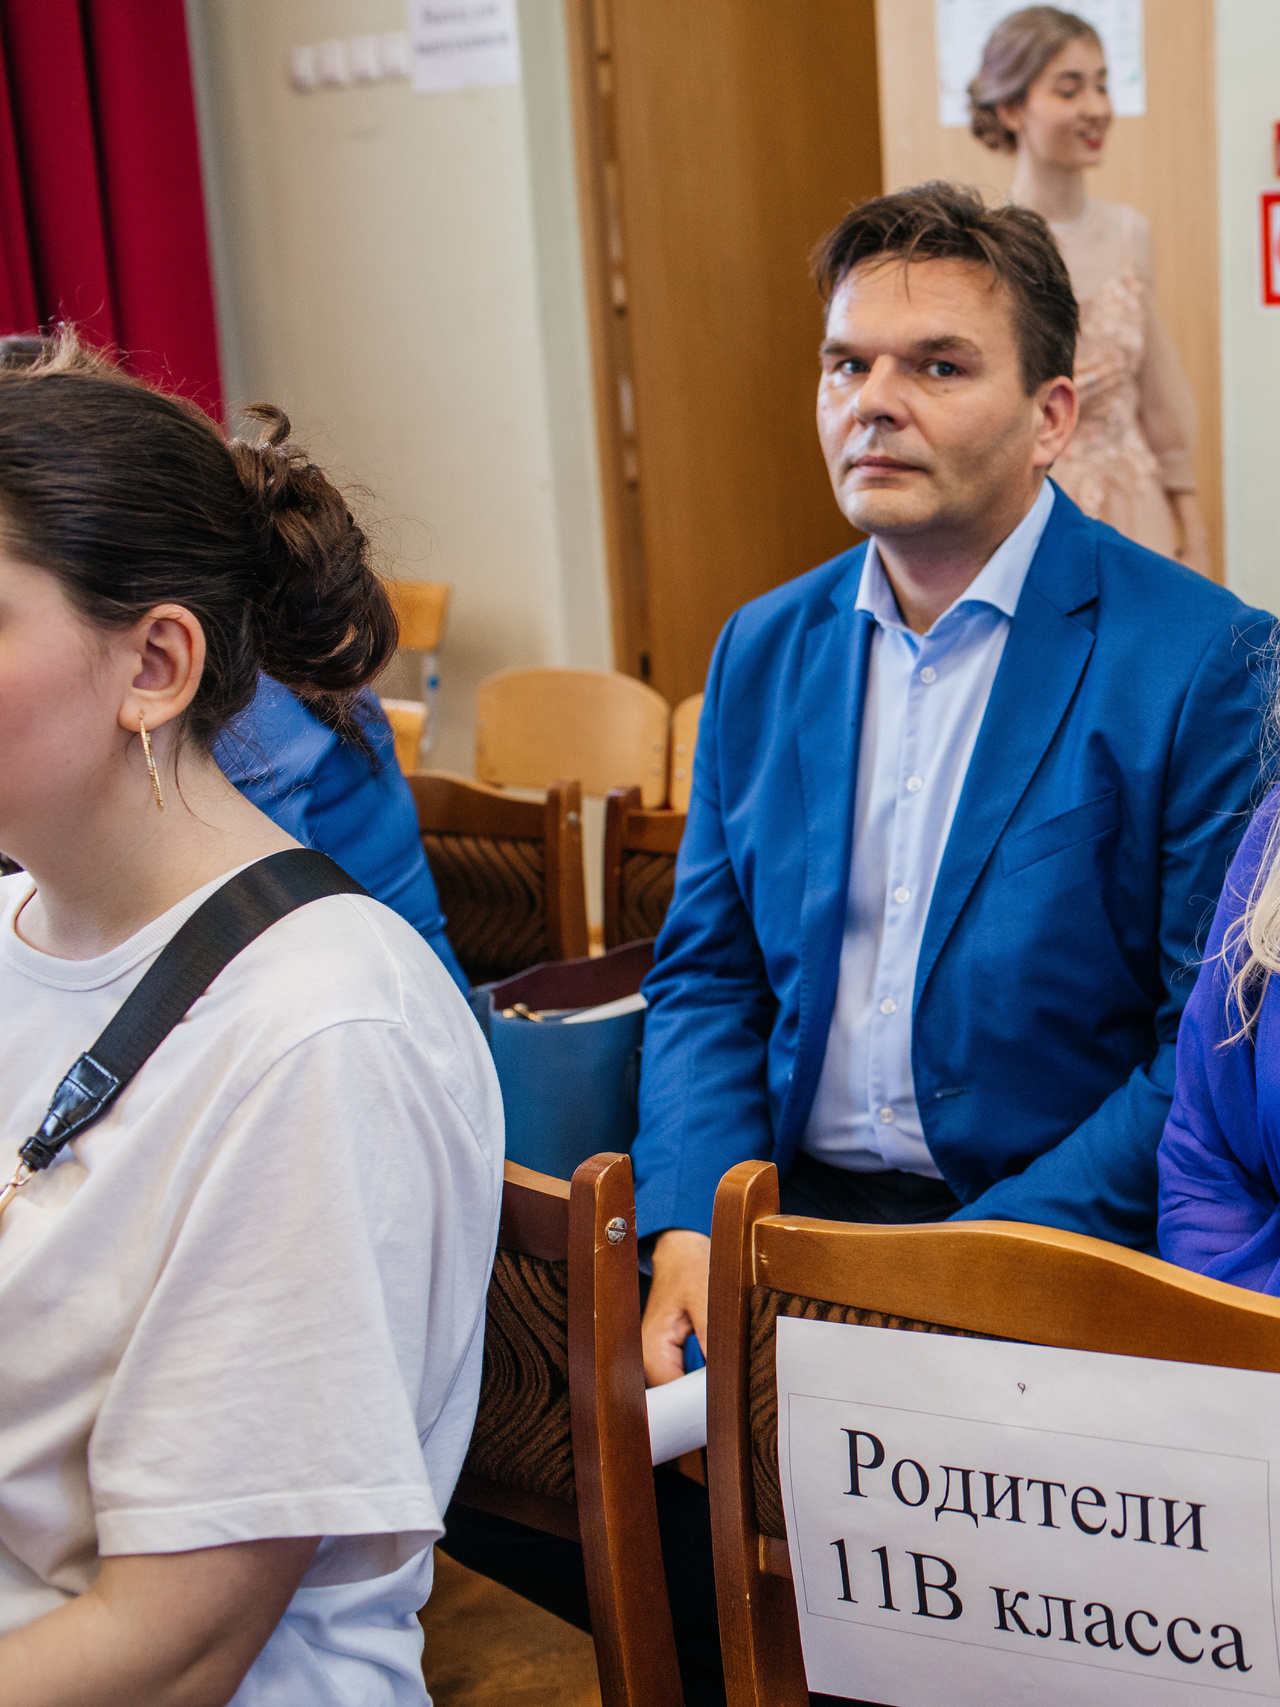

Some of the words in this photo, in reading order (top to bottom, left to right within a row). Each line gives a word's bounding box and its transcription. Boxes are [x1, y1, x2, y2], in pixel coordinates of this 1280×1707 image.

[840, 1427, 1209, 1553] Родители
[829, 1538, 964, 1622] 11В
[988, 1585, 1253, 1673] класса
